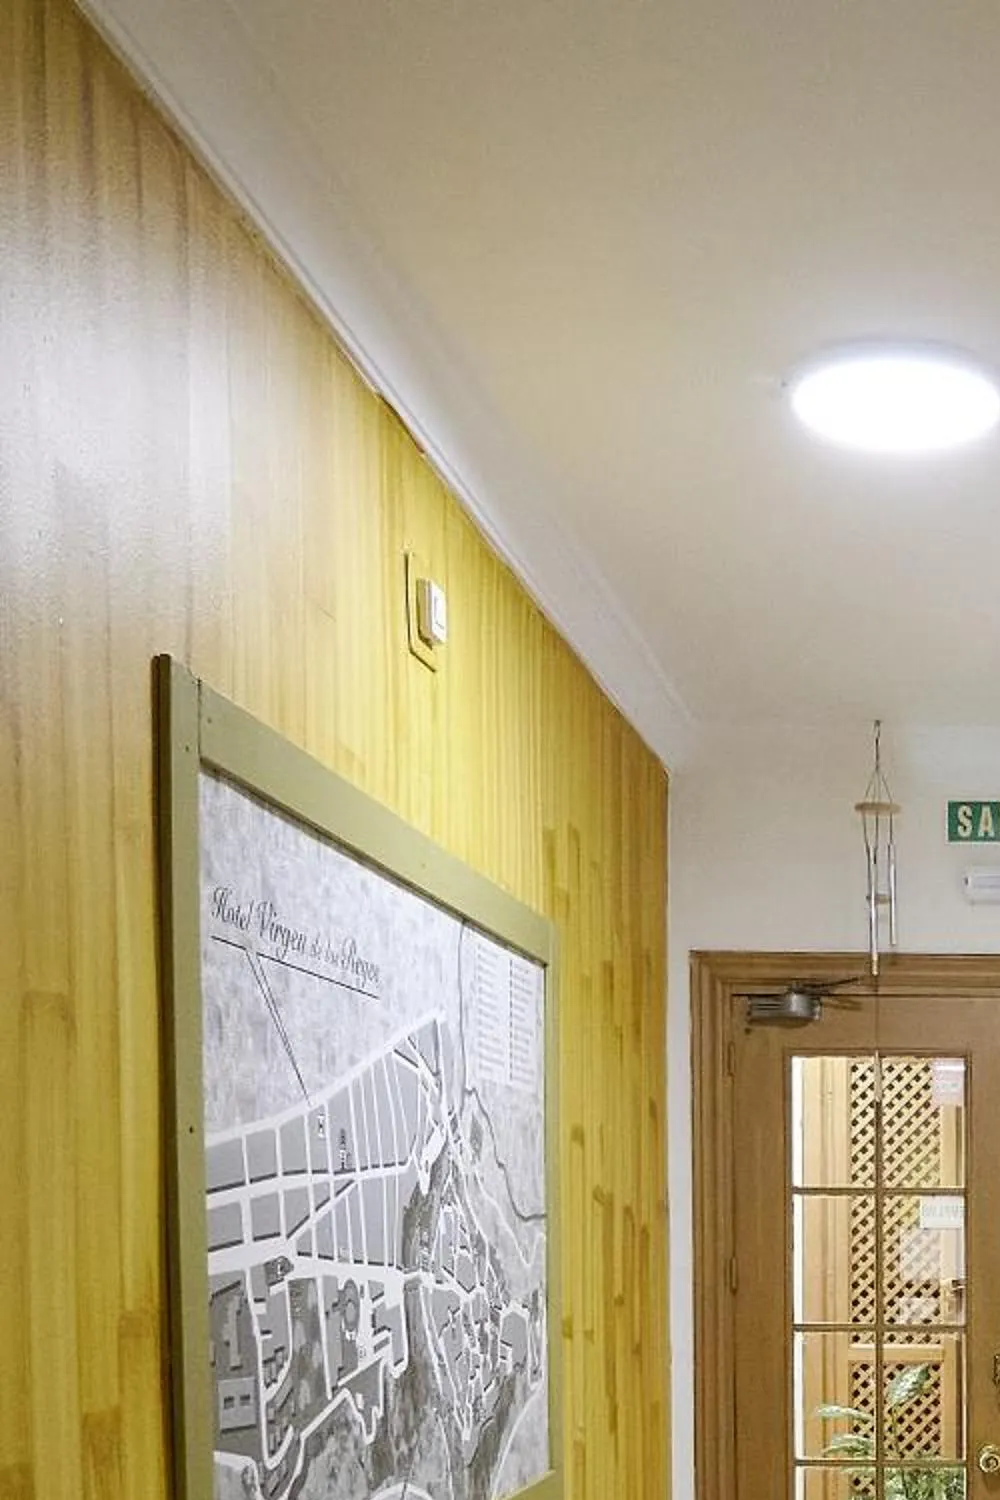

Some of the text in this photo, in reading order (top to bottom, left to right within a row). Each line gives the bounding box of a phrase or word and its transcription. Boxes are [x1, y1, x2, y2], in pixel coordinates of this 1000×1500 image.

[211, 886, 254, 931] Hotel
[256, 900, 307, 960] Virgen
[341, 936, 382, 988] Reyes
